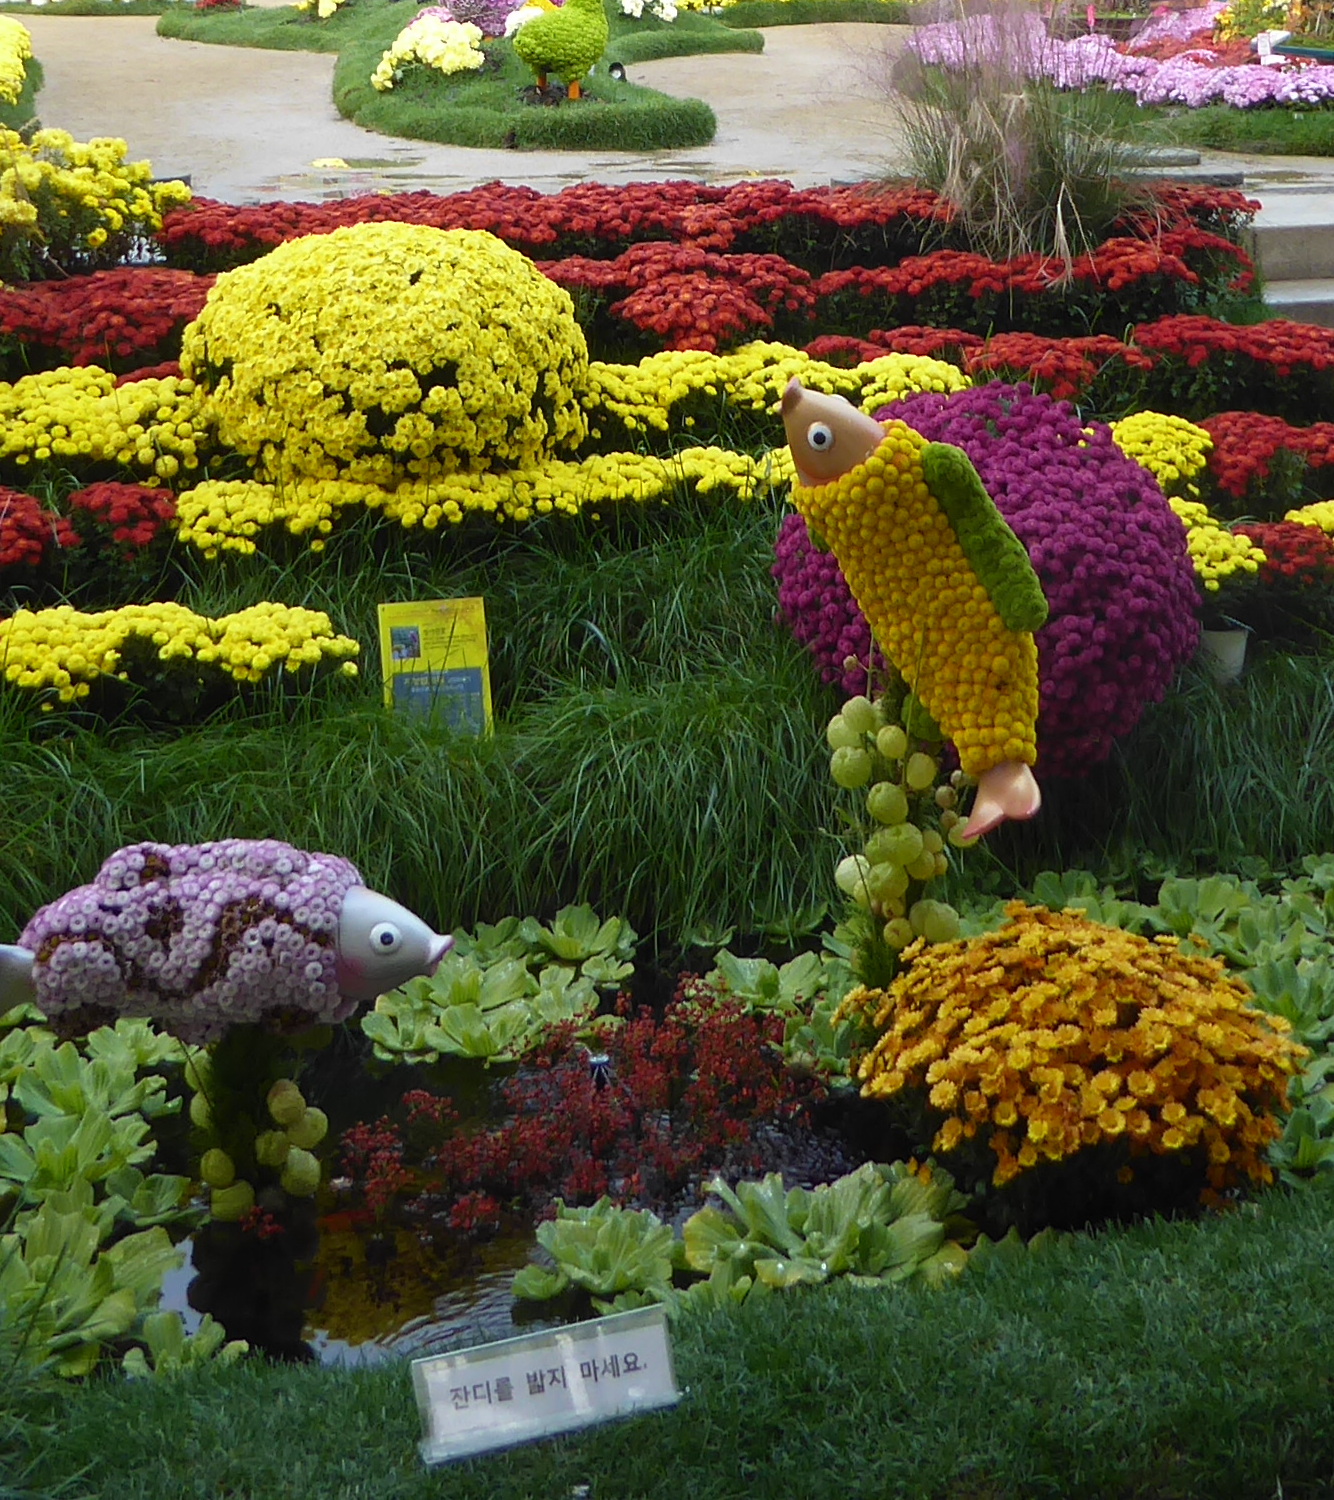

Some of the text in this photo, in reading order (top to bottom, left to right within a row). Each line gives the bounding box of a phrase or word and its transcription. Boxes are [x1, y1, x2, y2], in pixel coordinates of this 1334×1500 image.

[450, 1352, 648, 1411] 잔디를 밟지 마세요.
